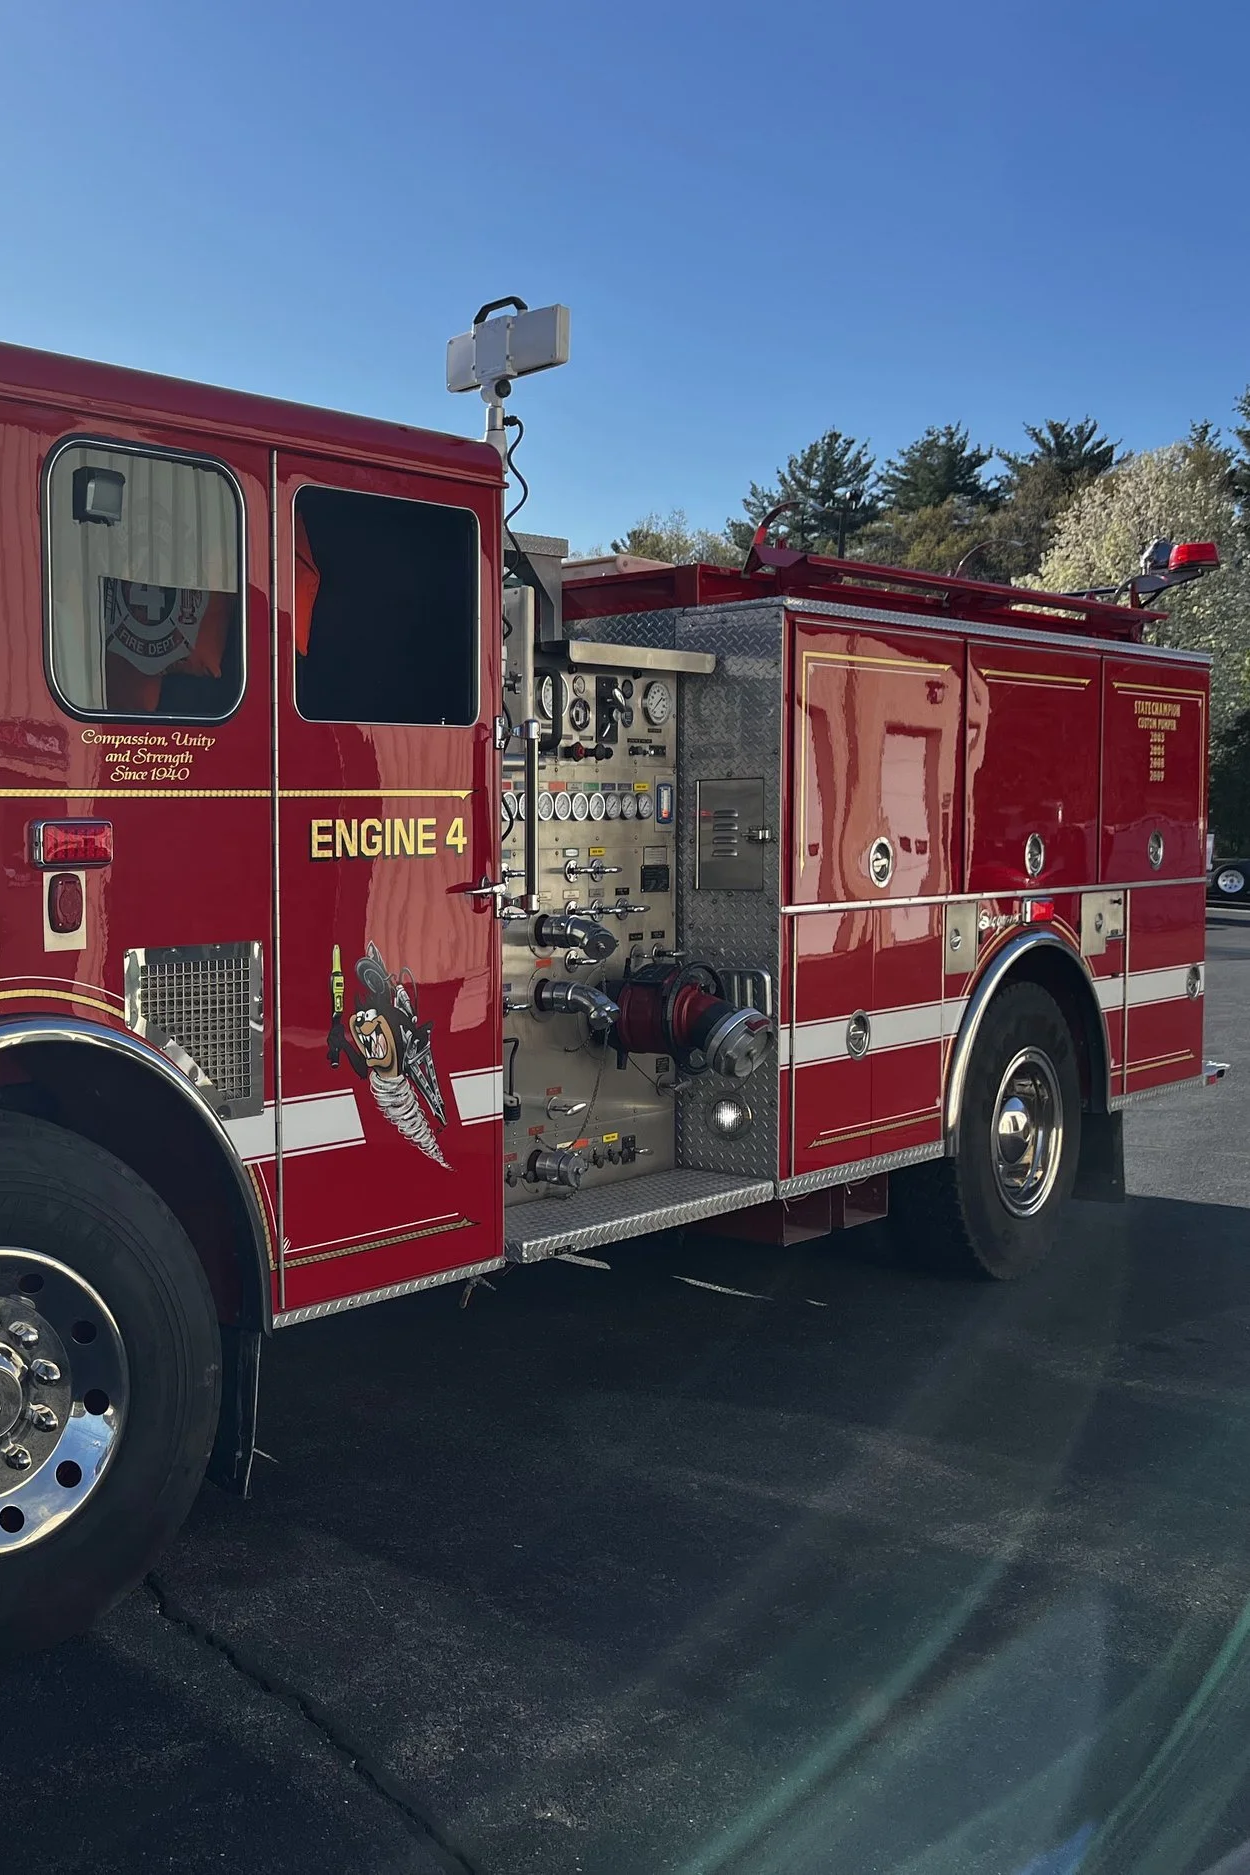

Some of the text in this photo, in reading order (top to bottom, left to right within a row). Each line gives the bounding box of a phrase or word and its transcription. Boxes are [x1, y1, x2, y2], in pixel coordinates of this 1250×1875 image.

[119, 628, 145, 654] FIRE
[81, 729, 216, 751] Compassion, Unity
[105, 748, 194, 768] and Strength
[110, 765, 190, 782] Since 1940
[310, 816, 469, 860] ENGINE 4
